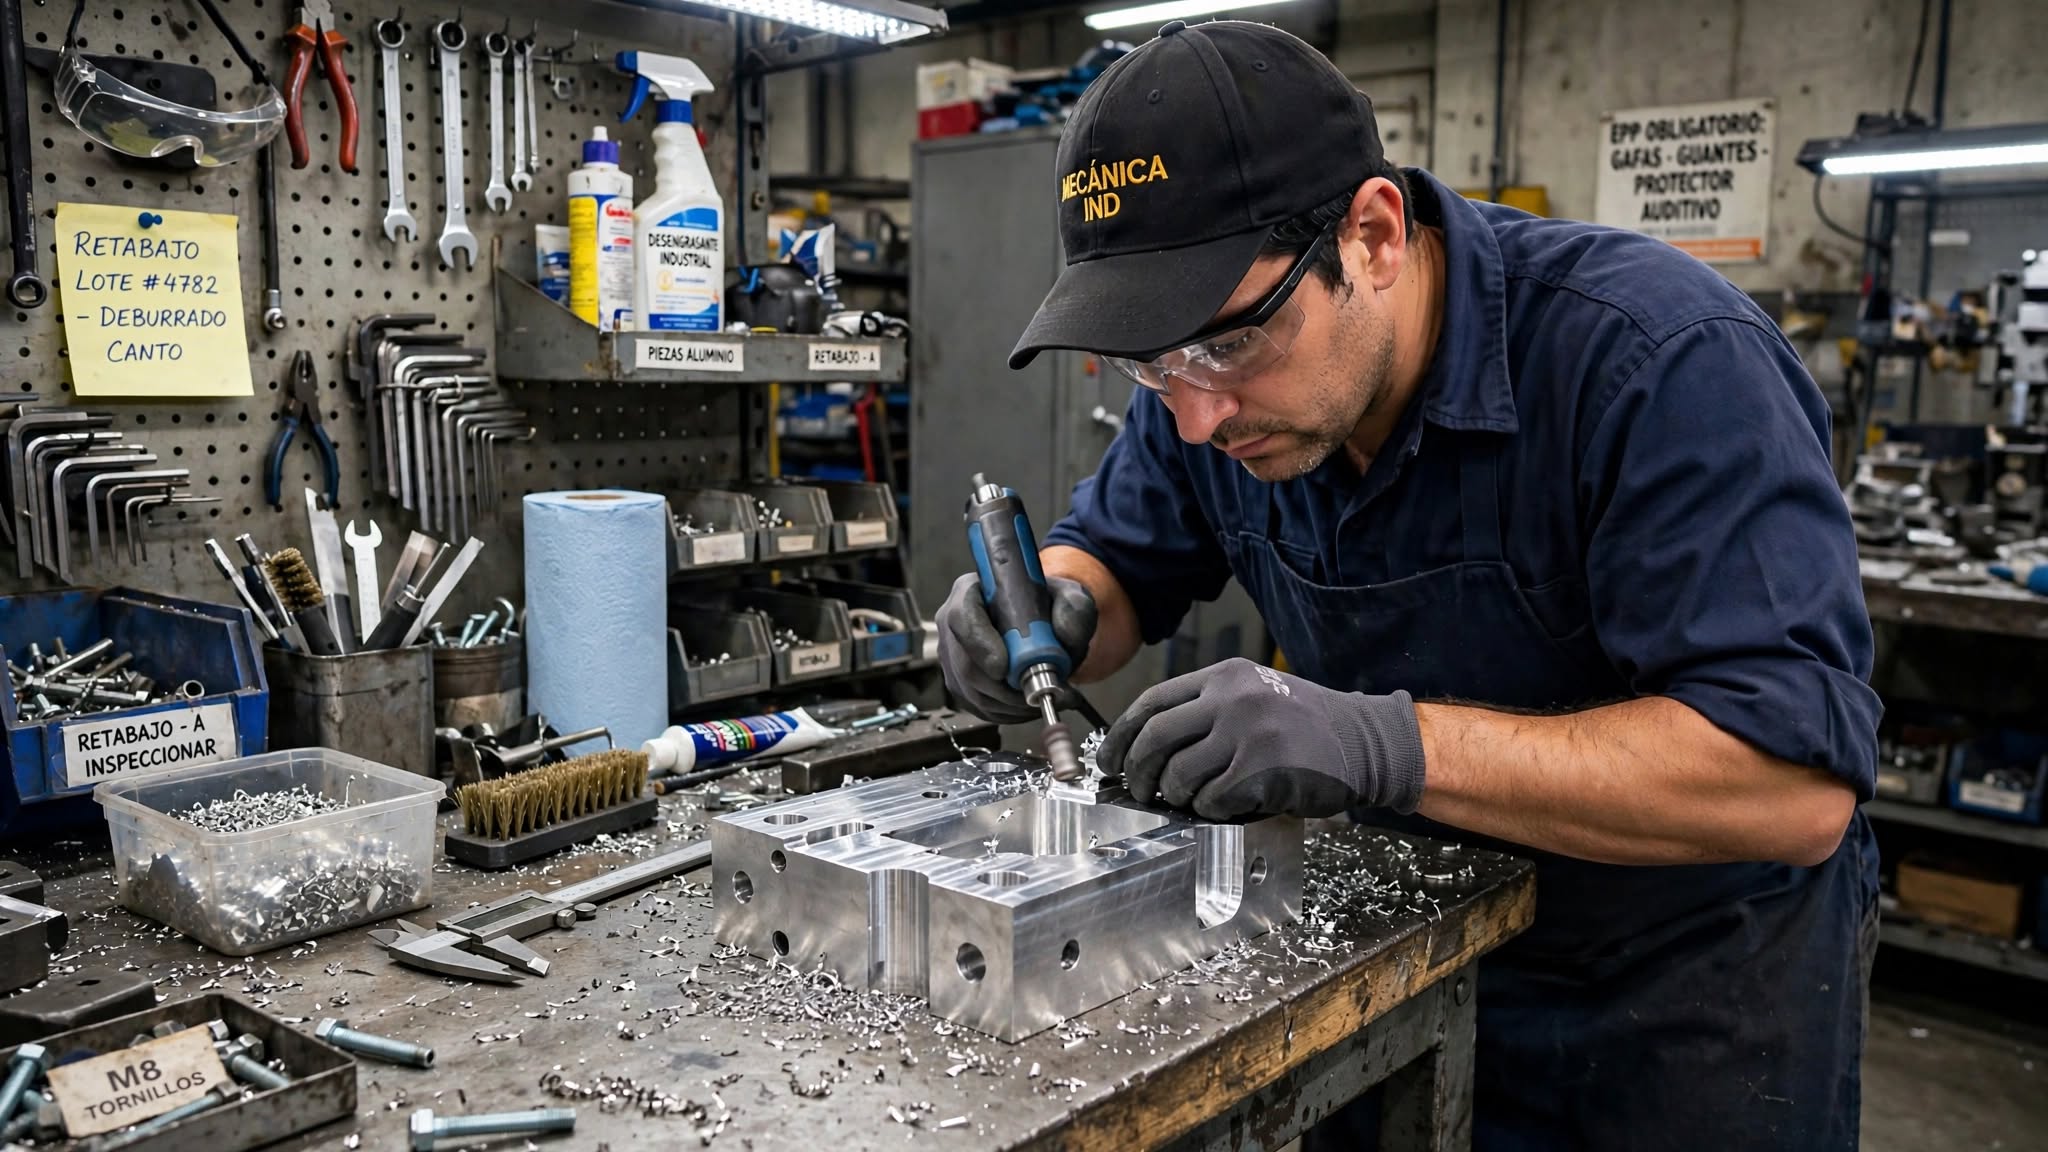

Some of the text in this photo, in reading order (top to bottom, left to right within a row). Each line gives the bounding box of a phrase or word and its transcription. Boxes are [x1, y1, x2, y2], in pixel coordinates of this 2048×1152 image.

[1610, 111, 1766, 145] EPP OBLIGATORIO:
[1610, 147, 1662, 170] GAFAS
[1676, 140, 1757, 166] GUANTES
[1061, 154, 1169, 203] MECÁNICA
[1634, 169, 1734, 195] PROTECTOR
[1083, 192, 1121, 222] IND
[1641, 197, 1721, 222] AUDITIVO
[73, 230, 200, 260] RETABAJO
[648, 233, 719, 251] DESENGRASANTE
[659, 251, 712, 268] INDUSTRIAL
[76, 269, 219, 295] LOTE #4782
[100, 305, 227, 328] DEBURRADO
[107, 340, 183, 362] CANTO
[648, 345, 735, 364] PIEZAS ALUMINIO
[814, 350, 860, 365] RETABAJO
[869, 350, 876, 364] A
[77, 719, 174, 753] RETABAJO
[193, 713, 206, 733] A
[85, 738, 217, 777] INSPECCIONAR
[106, 1059, 162, 1093] M8
[84, 1071, 206, 1120] TORNILLOS
